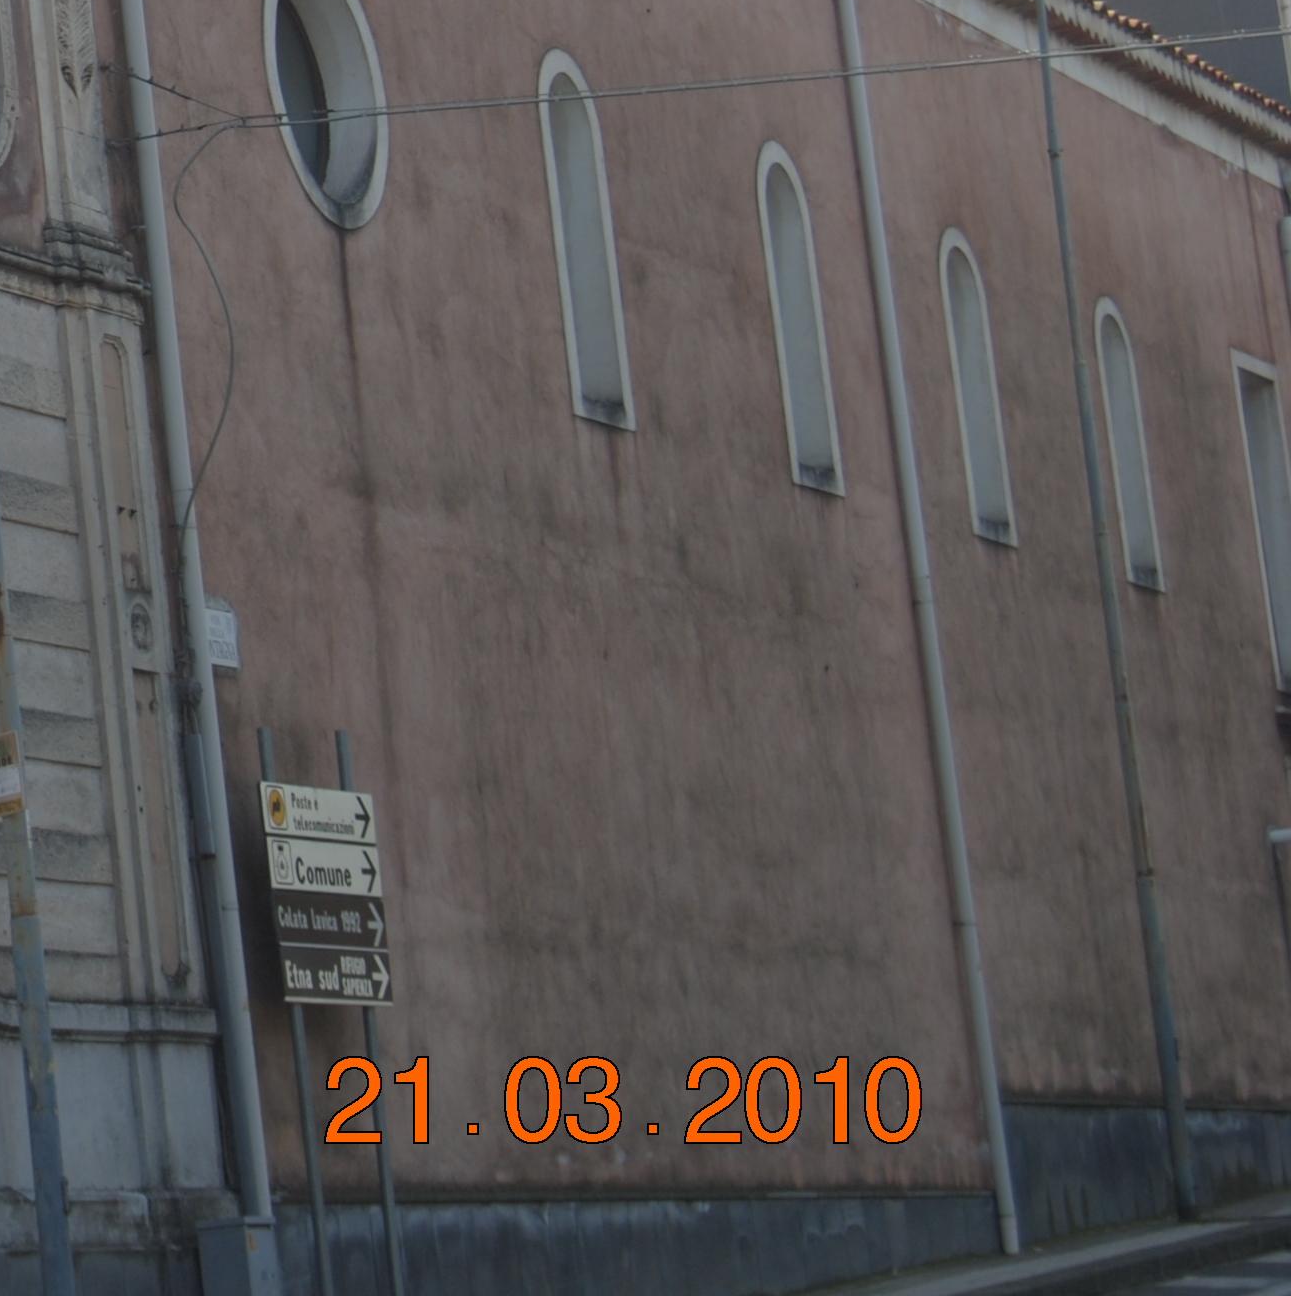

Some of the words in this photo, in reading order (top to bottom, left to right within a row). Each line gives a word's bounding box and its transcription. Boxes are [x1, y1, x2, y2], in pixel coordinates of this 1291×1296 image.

[290, 792, 312, 810] Poste
[295, 856, 352, 887] Comune
[278, 905, 309, 930] Colata
[285, 960, 314, 989] Etna
[318, 964, 340, 991] sud
